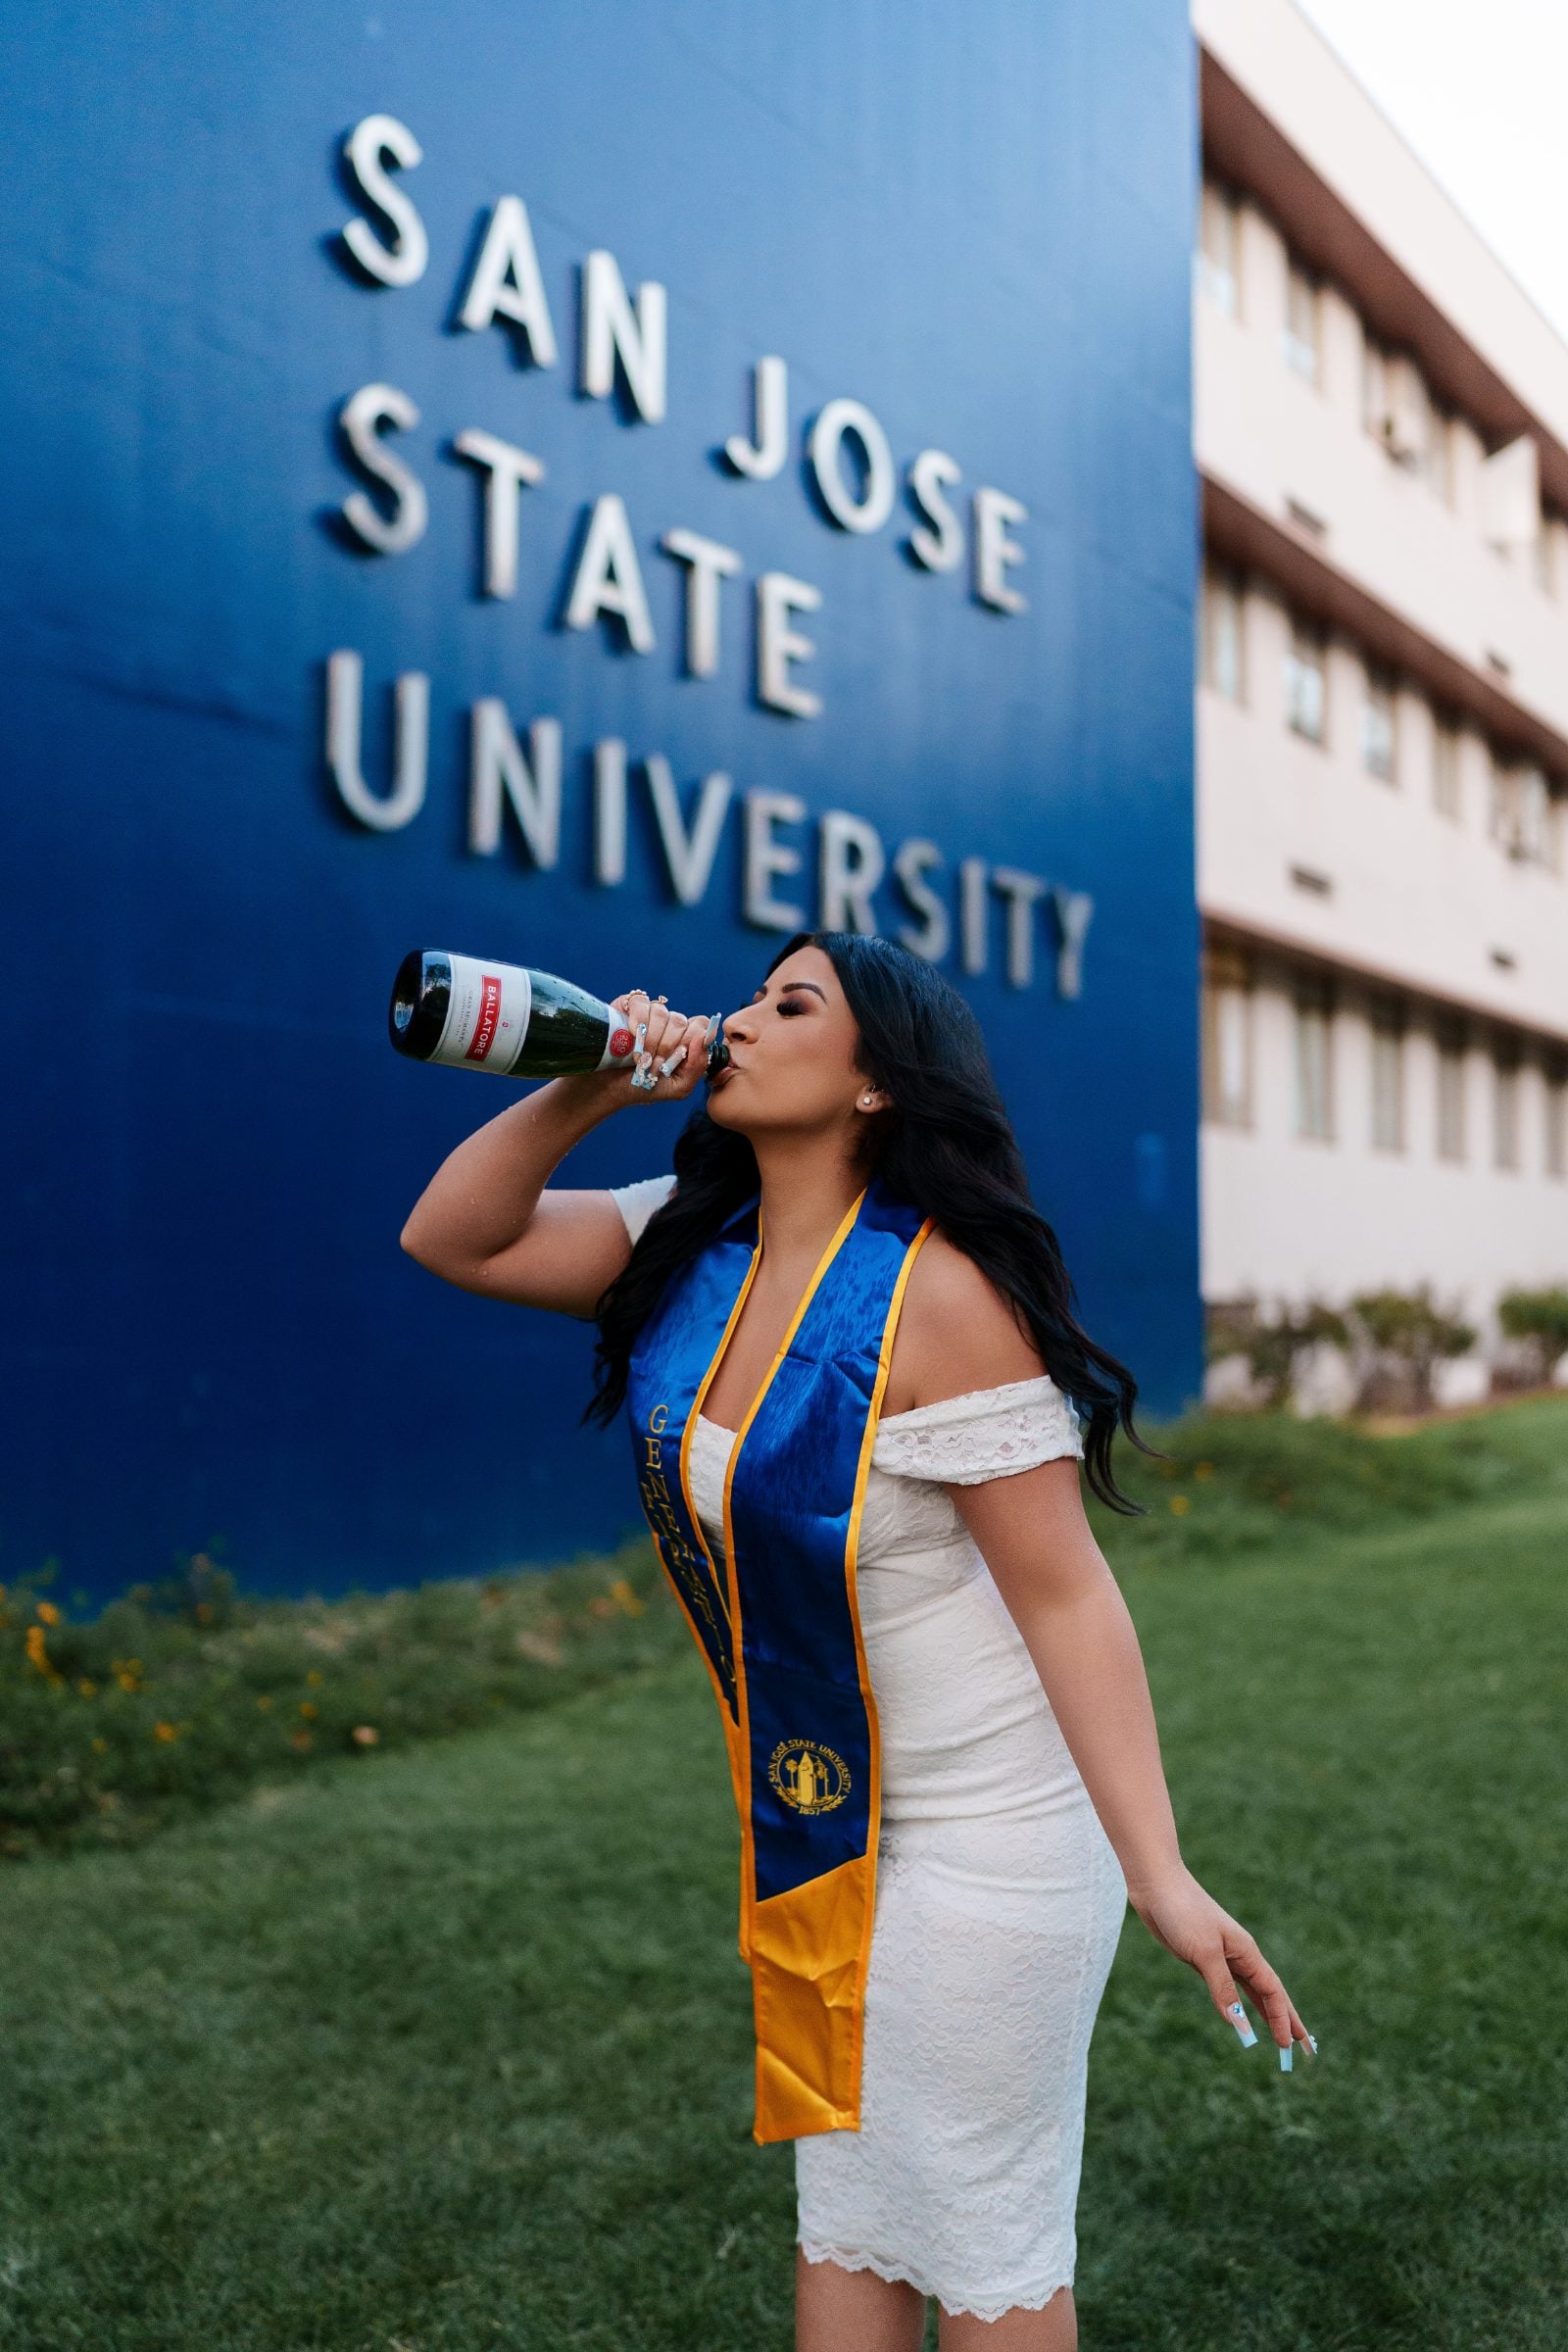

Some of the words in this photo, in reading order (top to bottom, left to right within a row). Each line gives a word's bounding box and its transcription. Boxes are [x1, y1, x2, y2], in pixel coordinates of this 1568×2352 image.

[342, 114, 667, 425] SAN
[725, 356, 1027, 613] JOSE
[340, 383, 822, 718] STATE
[326, 649, 1094, 1000] UNIVERSITY
[473, 985, 497, 1054] BALLATORE
[768, 1763, 779, 1783] SAN
[787, 1739, 816, 1749] STATE
[818, 1744, 852, 1793] UNIVERSITY
[799, 1806, 821, 1816] 1857
